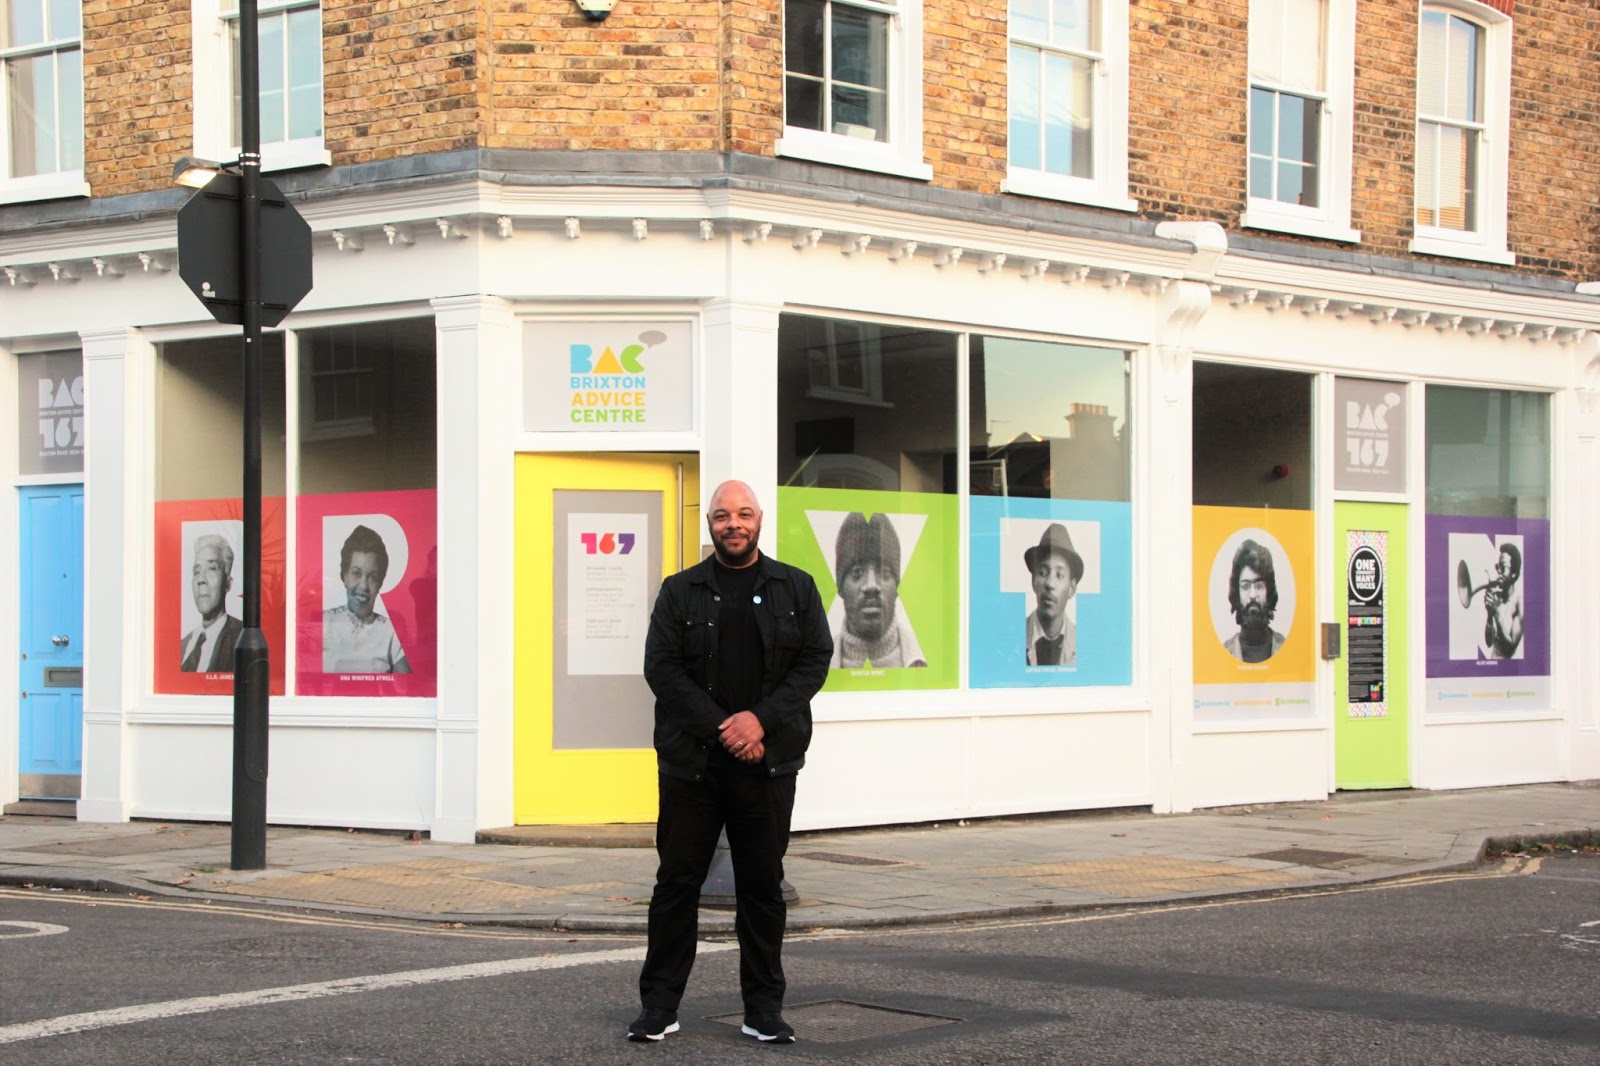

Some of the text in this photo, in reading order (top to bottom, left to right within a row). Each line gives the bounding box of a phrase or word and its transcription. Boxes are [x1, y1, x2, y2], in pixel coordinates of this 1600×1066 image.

[569, 344, 645, 374] BAC
[570, 377, 646, 389] BRIXTON
[571, 392, 646, 406] ADVICE
[570, 409, 646, 423] CENTRE
[1346, 400, 1389, 431] BAC
[1346, 437, 1389, 467] 167
[581, 533, 635, 555] 167
[1355, 558, 1376, 571] ONE
[1355, 574, 1376, 583] MANY
[1355, 582, 1376, 590] VOICES
